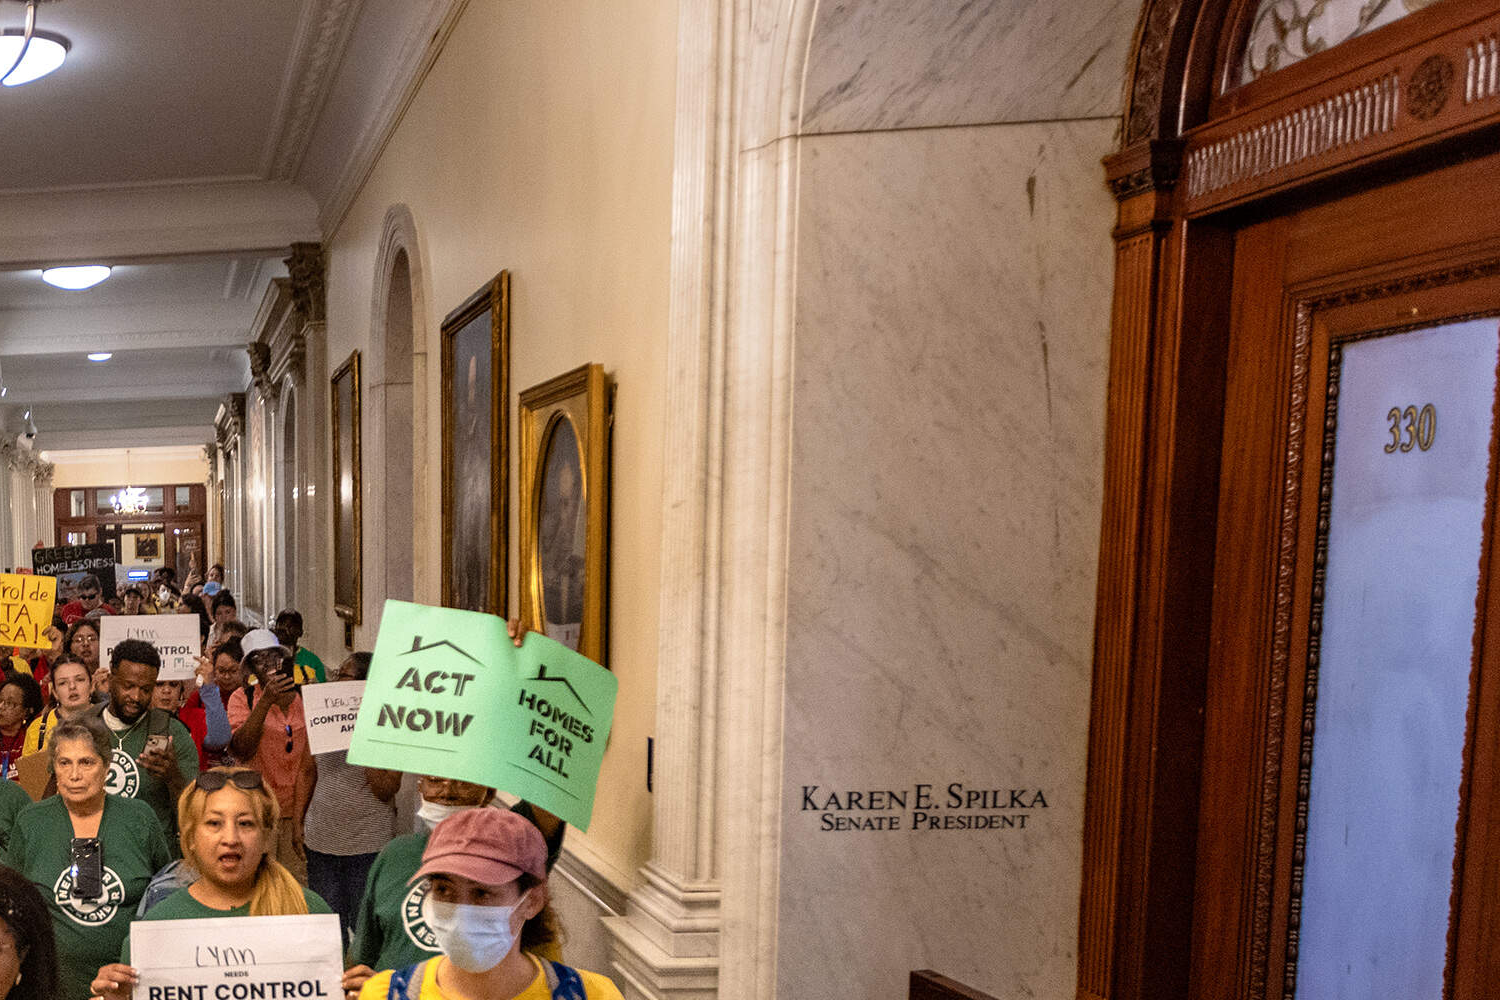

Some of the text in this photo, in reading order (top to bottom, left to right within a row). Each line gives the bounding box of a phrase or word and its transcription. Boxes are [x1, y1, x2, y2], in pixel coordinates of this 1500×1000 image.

[1384, 403, 1436, 454] 330
[37, 558, 114, 574] HOMELESSNESS
[29, 581, 48, 601] de
[156, 646, 193, 655] NTROL
[395, 667, 475, 697] ACT
[376, 704, 474, 737] NOW
[518, 689, 594, 744] HOMES
[528, 720, 573, 758] FOR
[528, 745, 569, 779] ALL
[105, 768, 118, 788] 2
[802, 783, 1049, 811] KAREN E. SPILKA
[821, 811, 1031, 831] SENATE PRESIDENT
[215, 980, 328, 1000] CONTROL
